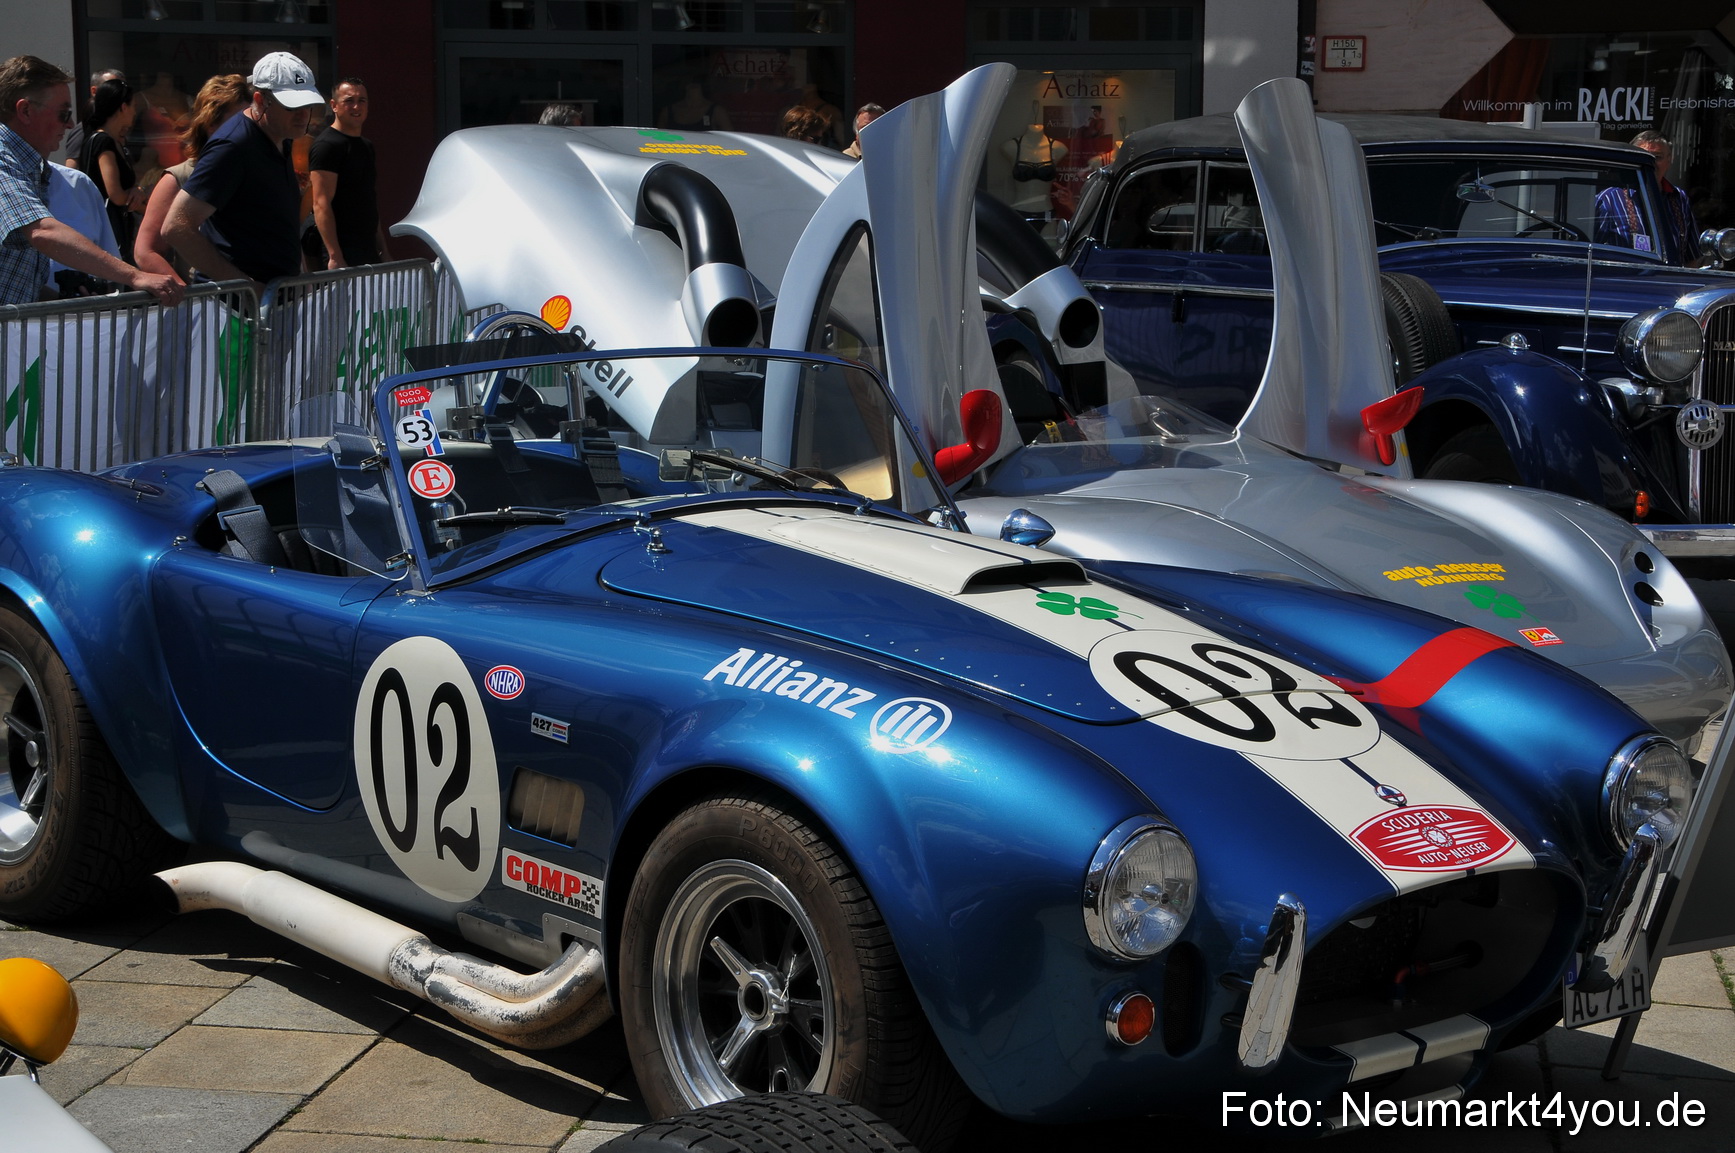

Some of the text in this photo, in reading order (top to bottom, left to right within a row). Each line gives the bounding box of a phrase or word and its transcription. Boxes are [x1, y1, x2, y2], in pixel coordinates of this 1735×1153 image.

[711, 51, 787, 75] Achatz
[1042, 74, 1121, 99] Achatz
[1463, 86, 1735, 121] Willkommn im RACKL Erlebnisha
[1602, 122, 1616, 131] Tag
[398, 389, 421, 398] 1000
[400, 395, 426, 405] MIGLIA
[403, 419, 433, 443] 53
[418, 467, 446, 492] E
[1382, 562, 1507, 582] auto-neuser
[1414, 573, 1505, 588] NÜRNBERG
[491, 671, 519, 694] NHRA
[702, 646, 878, 720] Allianz
[1113, 643, 1362, 742] 02
[532, 717, 552, 732] 427
[370, 667, 480, 872] 02
[1381, 810, 1453, 833] SCUDERIA
[1417, 841, 1492, 865] AUTO-NEUSER
[506, 855, 581, 898] COMP
[526, 882, 596, 915] ROCKER ARMS
[1568, 971, 1574, 982] D
